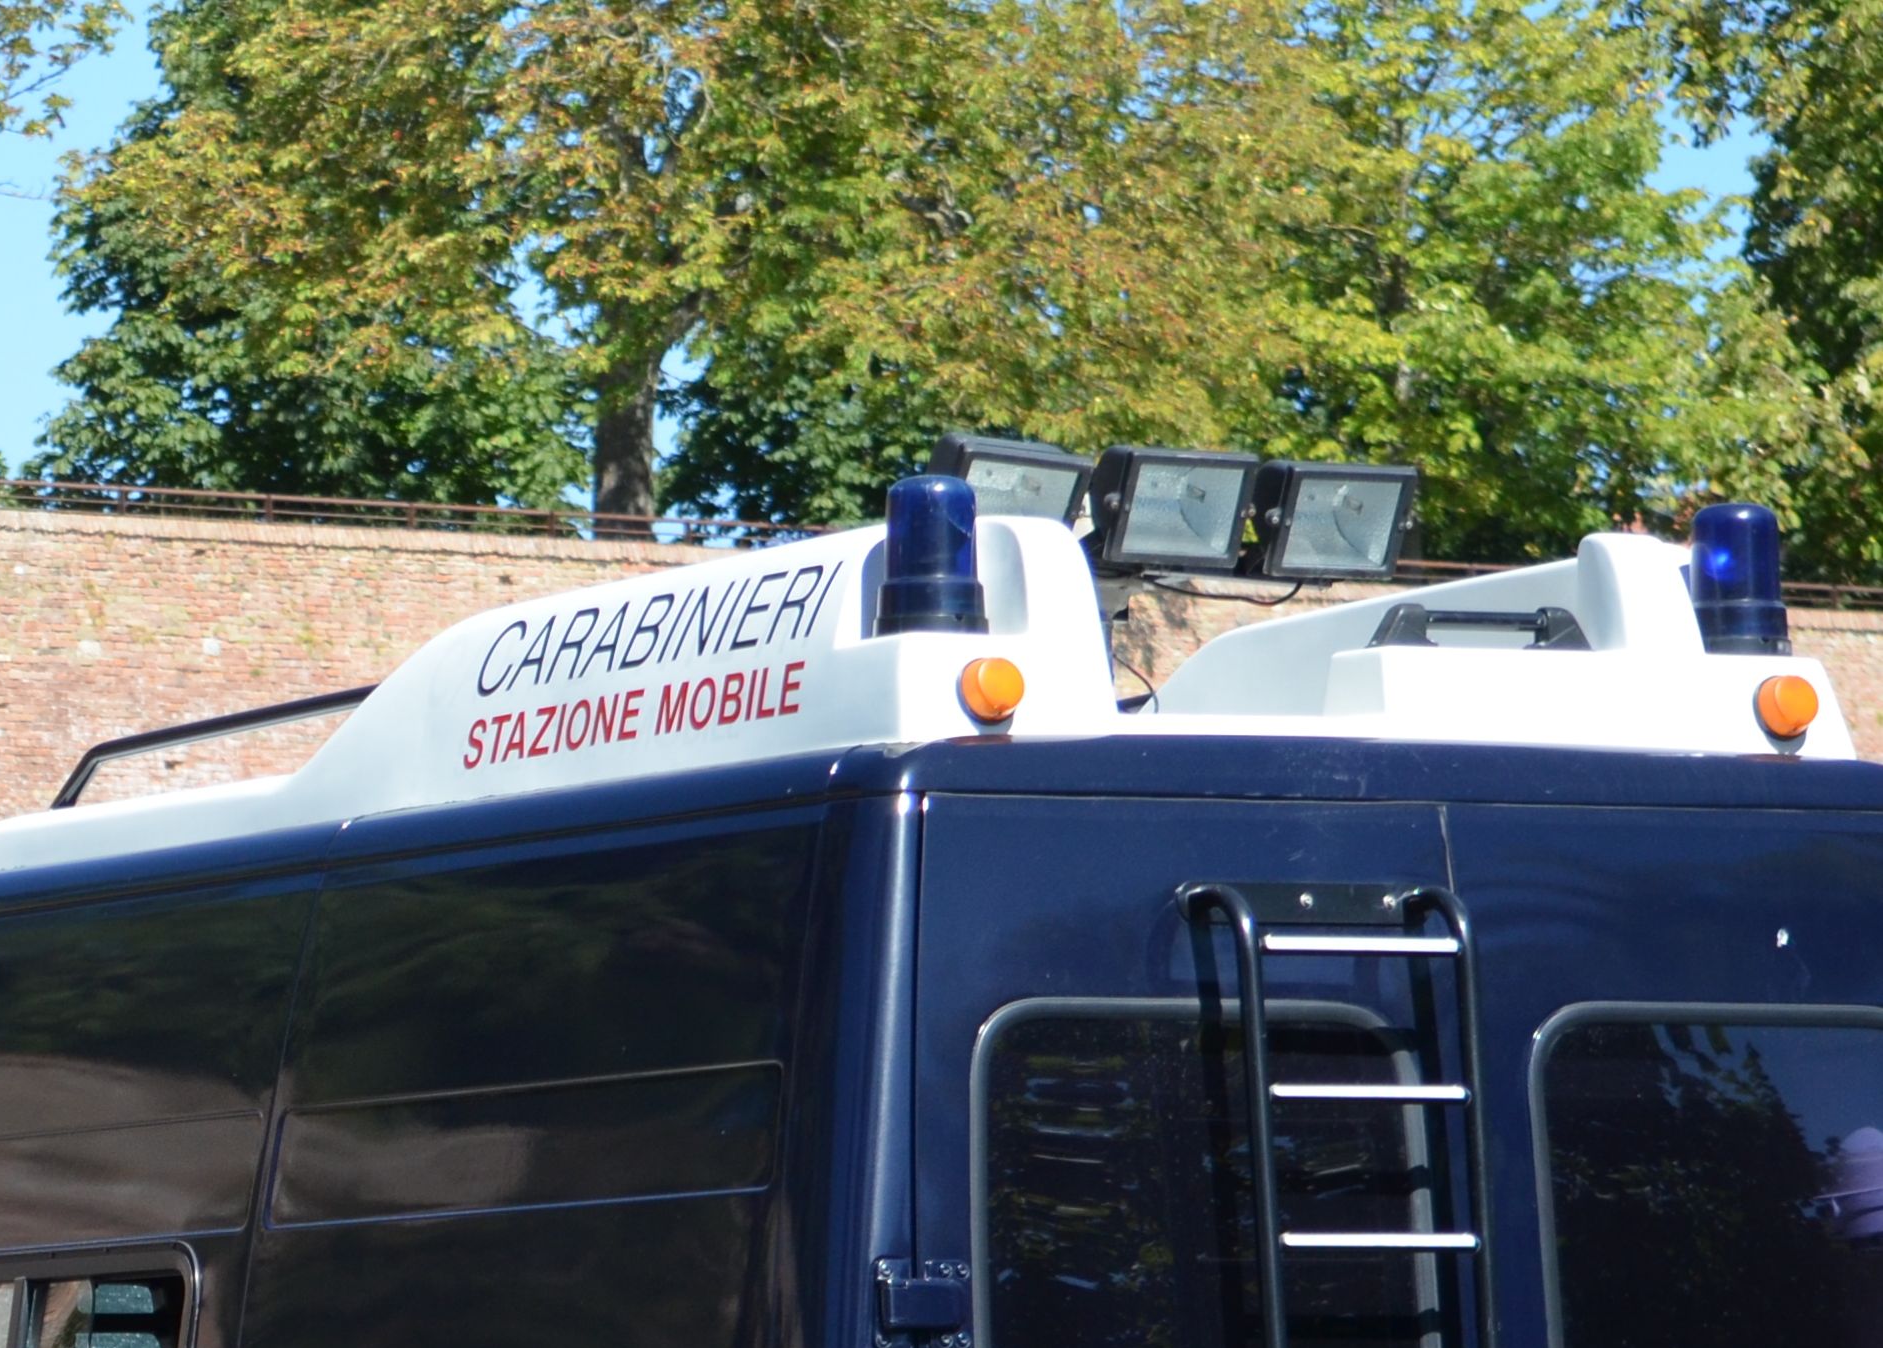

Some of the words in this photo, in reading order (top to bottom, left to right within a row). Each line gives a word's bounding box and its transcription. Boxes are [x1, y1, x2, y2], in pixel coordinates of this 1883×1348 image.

[477, 561, 843, 697] CARABINIERI
[463, 688, 645, 769] STAZIONE
[654, 661, 805, 736] MOBILE
